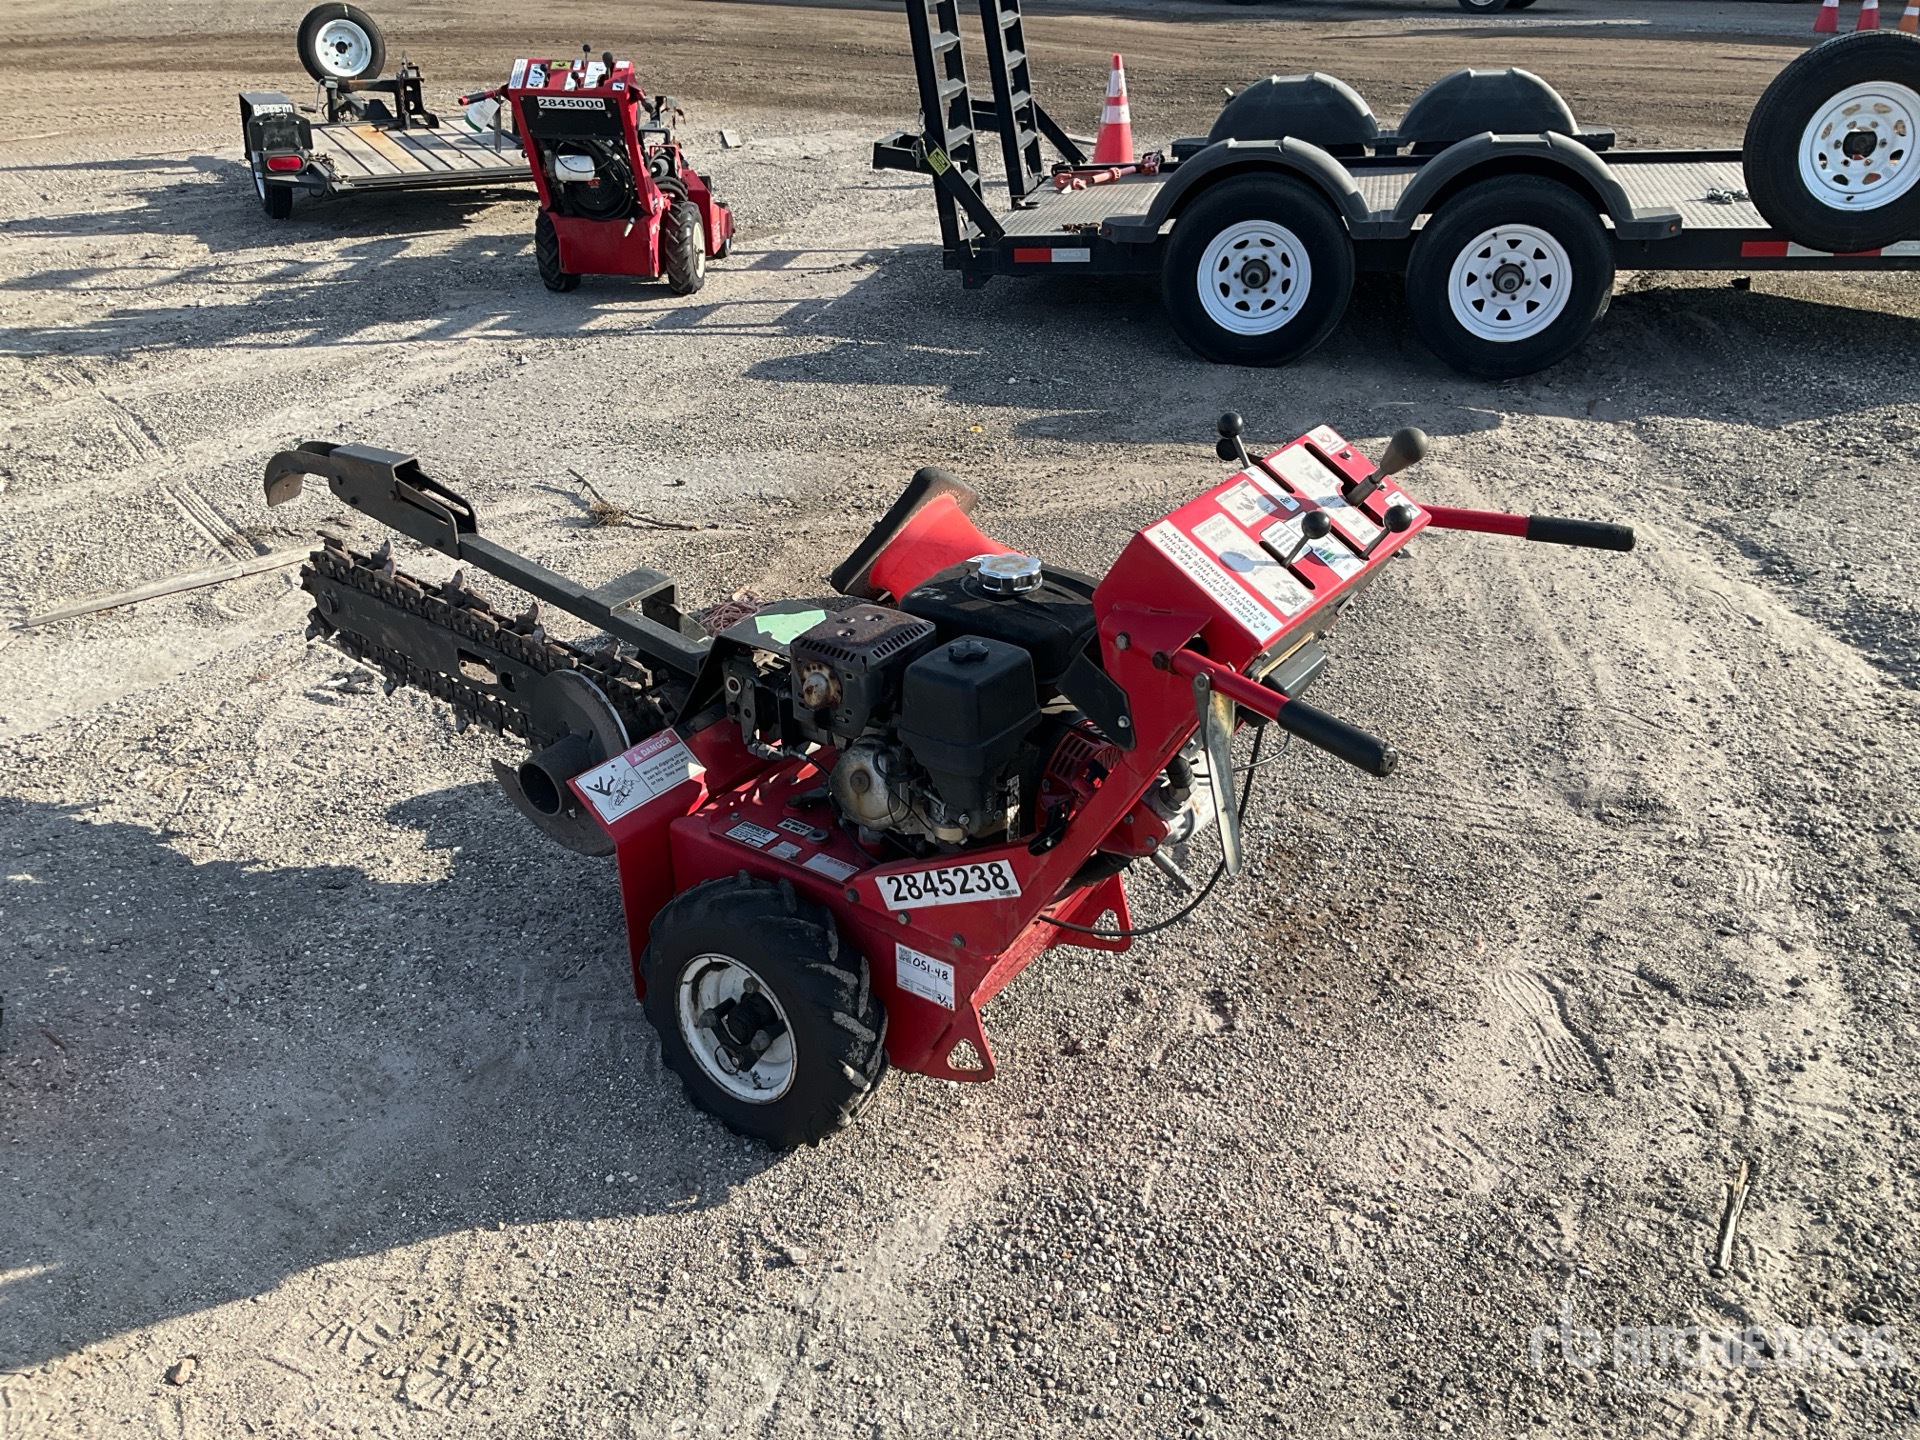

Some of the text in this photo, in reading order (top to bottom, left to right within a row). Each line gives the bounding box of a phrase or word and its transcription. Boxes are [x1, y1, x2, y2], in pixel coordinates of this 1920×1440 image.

[538, 98, 604, 109] 2845000
[1159, 538, 1177, 555] WILL
[1170, 532, 1199, 557] CLEAN
[1175, 554, 1194, 569] FEE
[1158, 528, 1272, 631] BE CHARGED IF THIS MACHINE
[1197, 556, 1241, 595] RETURNED
[1192, 568, 1234, 606] CLEANING
[1240, 595, 1258, 611] NOT
[1257, 611, 1267, 619] IS
[641, 737, 672, 757] DANGER
[643, 765, 659, 775] Moving
[673, 751, 685, 759] chain
[886, 862, 1010, 902] 2845238
